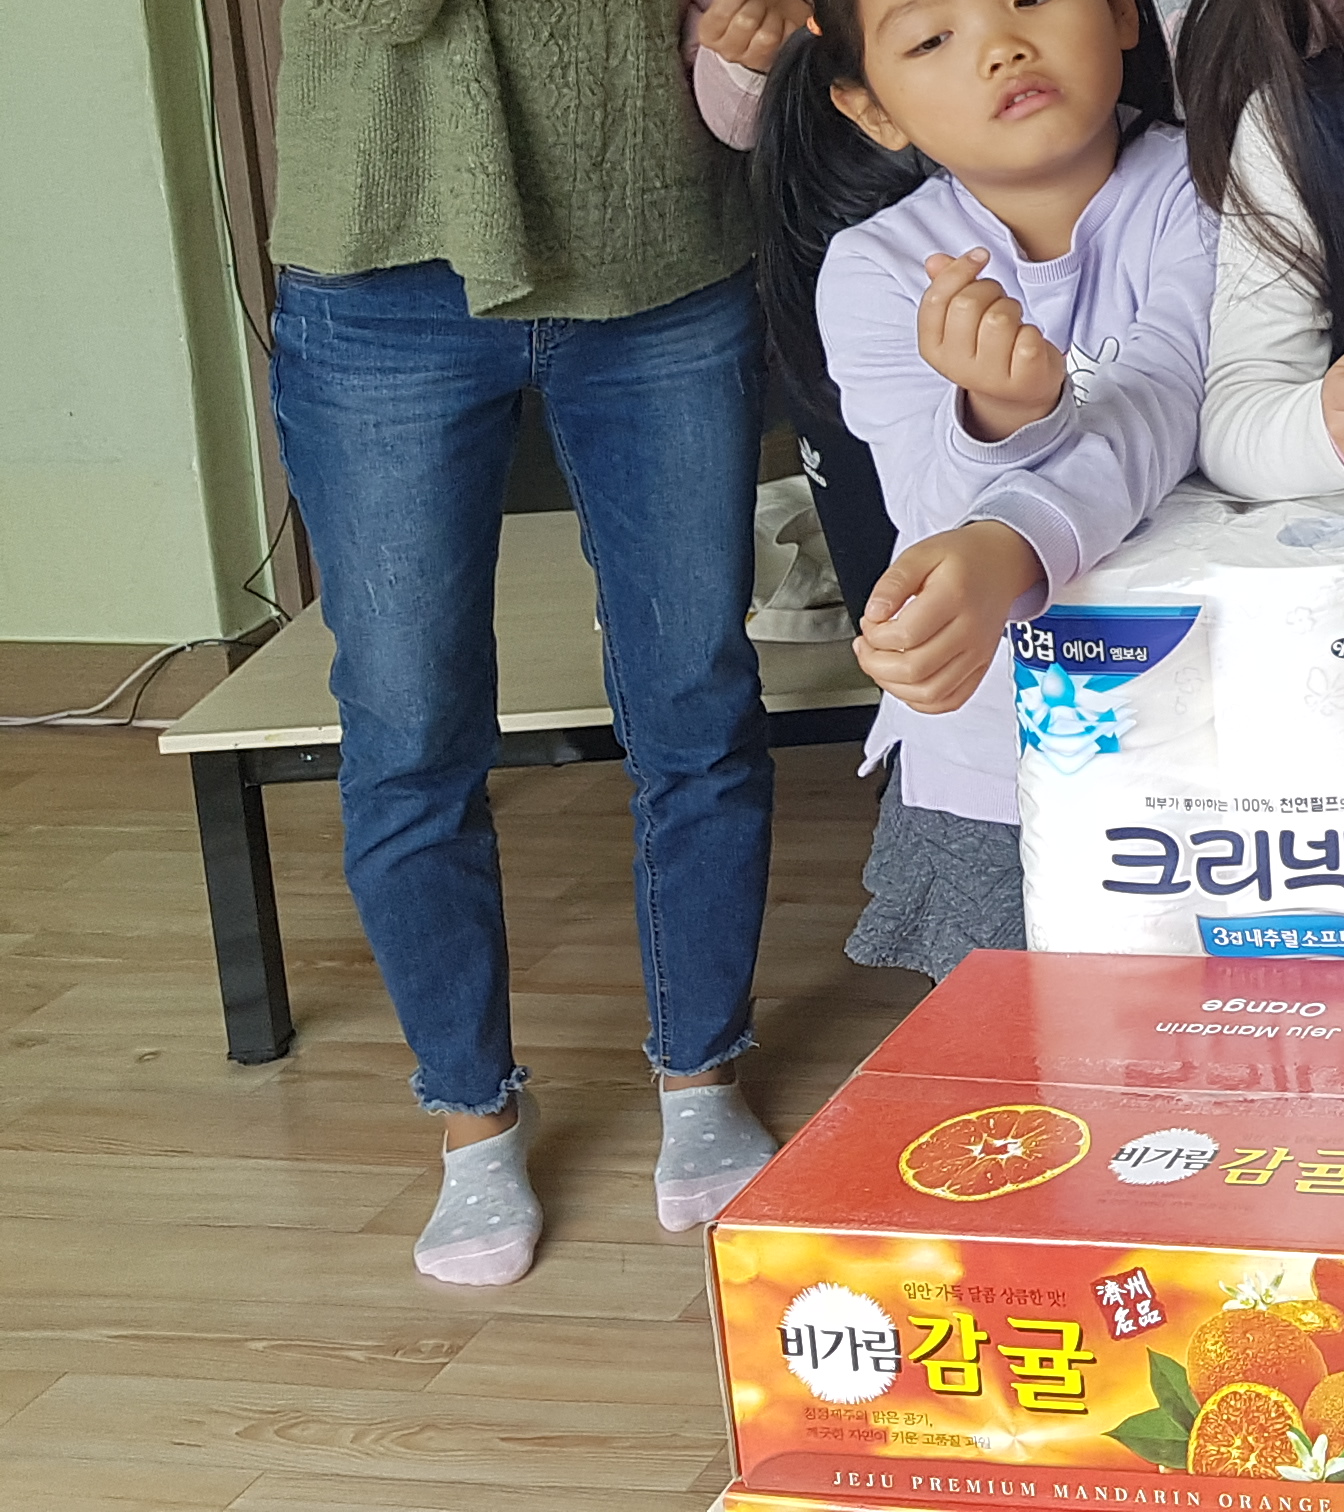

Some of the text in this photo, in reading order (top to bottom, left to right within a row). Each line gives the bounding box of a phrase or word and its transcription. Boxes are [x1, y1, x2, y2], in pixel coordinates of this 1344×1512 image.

[1016, 622, 1147, 662] 3겹 에어 엠보싱
[1145, 797, 1179, 810] 피부가
[1234, 798, 1274, 812] 100%
[1201, 998, 1327, 1017] Orange
[1155, 1022, 1342, 1039] Jeju Mandarin
[1112, 1145, 1219, 1171] 비가림
[903, 1283, 1067, 1308] 입안 가득 달콤 상큼한 맛!
[779, 1311, 1097, 1414] 비가림 감귤
[872, 1409, 900, 1426] 맑은
[891, 1431, 919, 1445] 키운
[922, 1432, 962, 1448] 고품질
[833, 1471, 1334, 1512] JEJU PREMIUM MANDARIN ORANGE
